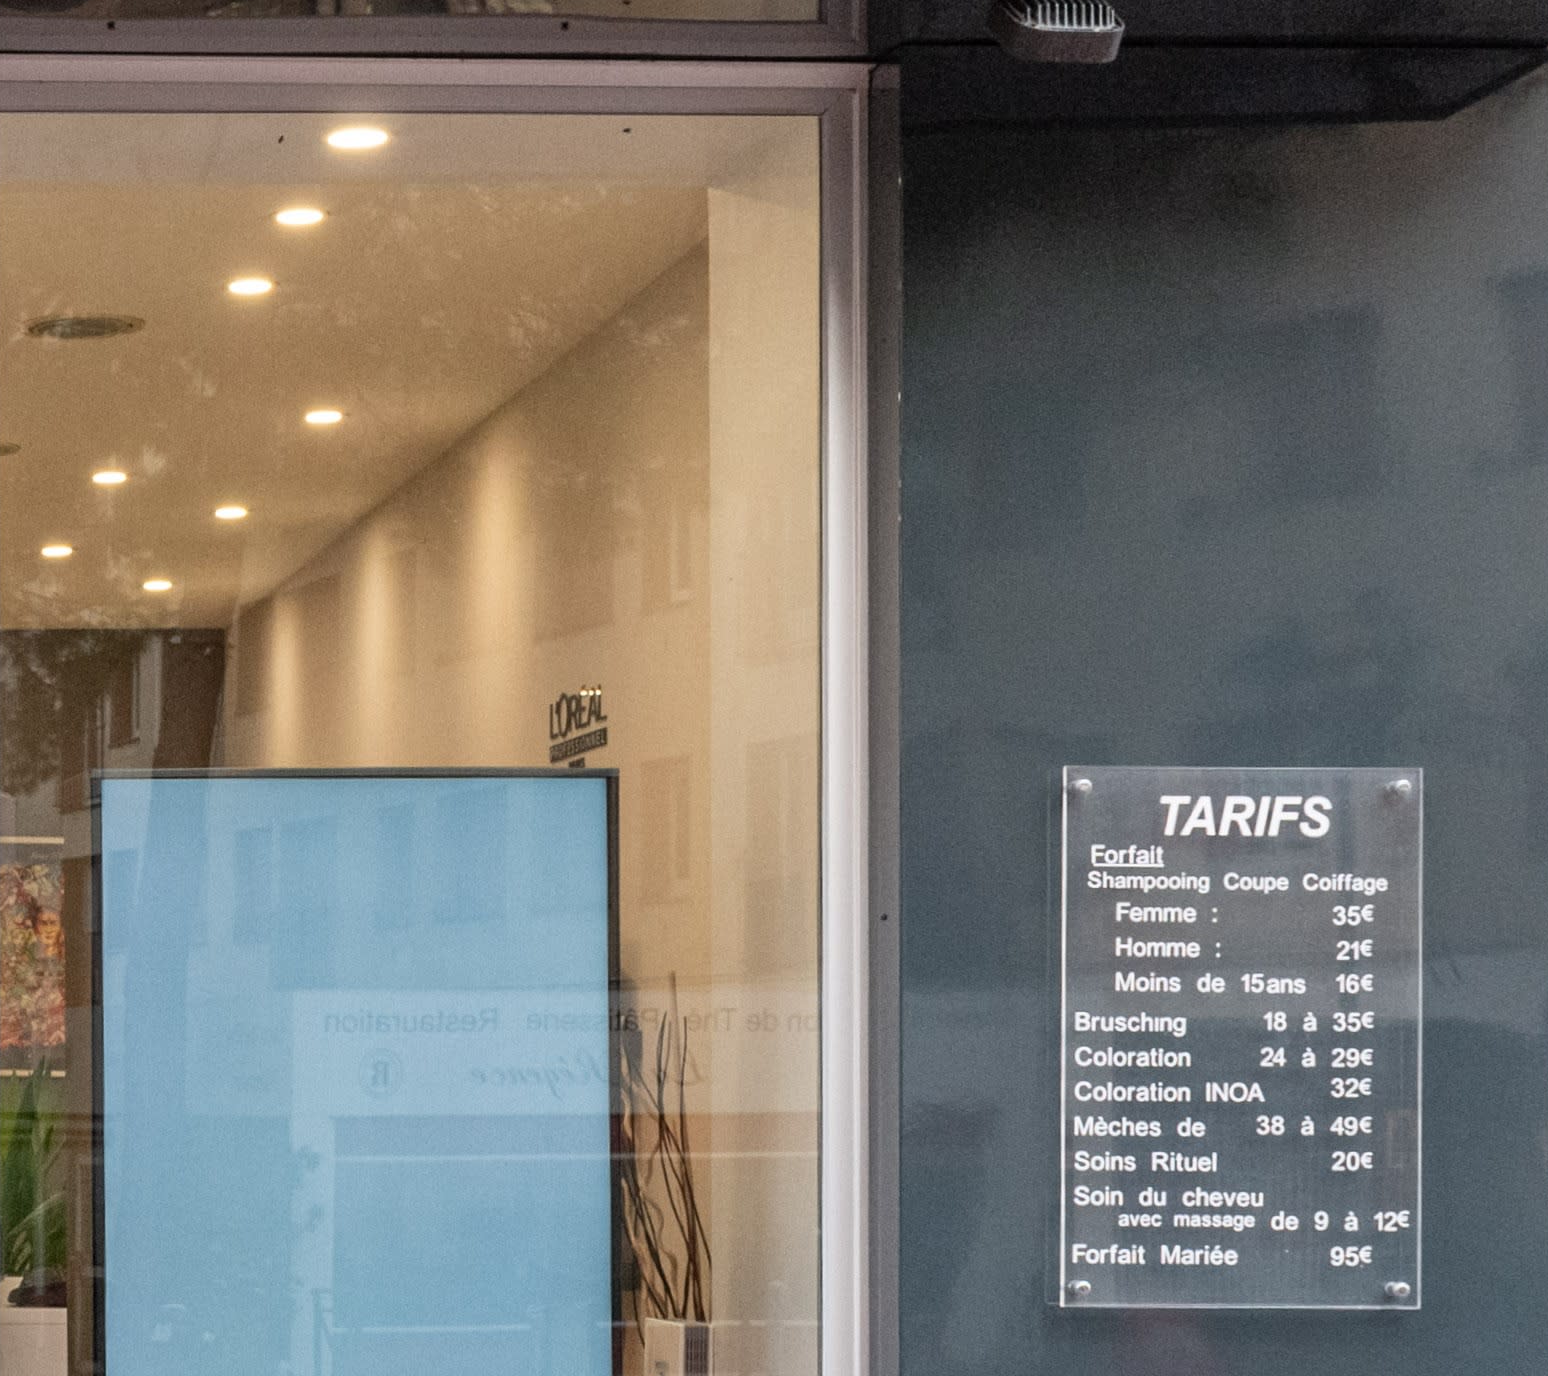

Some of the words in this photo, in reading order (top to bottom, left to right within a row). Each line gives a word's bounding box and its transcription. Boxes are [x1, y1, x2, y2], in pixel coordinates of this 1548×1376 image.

[1159, 795, 1333, 838] TARIFS
[1090, 844, 1165, 868] Forfait
[1087, 870, 1211, 894] Shampooing
[1223, 871, 1290, 895] Coupe
[1302, 872, 1389, 896] Coiffage
[1115, 901, 1197, 923] Femme
[1332, 904, 1374, 926] 35€
[1115, 936, 1201, 958] Homme
[1336, 938, 1373, 961] 21€
[1115, 971, 1182, 993] Moins
[1196, 972, 1226, 993] de
[1335, 973, 1374, 994] 16€
[1074, 1011, 1187, 1038] Brusching
[1263, 1011, 1288, 1032] 18
[1302, 1011, 1318, 1032] à
[1332, 1011, 1375, 1033] 35€
[1074, 1046, 1192, 1068] Coloration
[1259, 1046, 1287, 1067] 24
[1301, 1047, 1316, 1068] à
[1331, 1047, 1374, 1068] 29€
[1074, 1080, 1191, 1102] Coloration
[1205, 1081, 1266, 1103] INOA
[1330, 1077, 1372, 1098] 32€
[1073, 1115, 1162, 1137] Mèches
[1176, 1116, 1206, 1138] de
[1256, 1115, 1285, 1136] 38
[1300, 1115, 1315, 1136] à
[1329, 1115, 1373, 1137] 49€
[1074, 1150, 1137, 1172] Soins
[1151, 1151, 1218, 1173] Rituel
[1331, 1150, 1374, 1172] 20€
[1073, 1185, 1124, 1207] Soin
[1138, 1186, 1167, 1207] du
[1182, 1186, 1264, 1208] cheveu
[1117, 1213, 1163, 1228] avec
[1173, 1214, 1256, 1232] massage
[1270, 1210, 1299, 1231] de
[1313, 1210, 1329, 1231] 9
[1343, 1210, 1359, 1232] à
[1373, 1209, 1410, 1232] 12€
[1072, 1243, 1146, 1265] Forfait
[1160, 1244, 1239, 1266] Mariée
[1330, 1245, 1373, 1267] 95€
